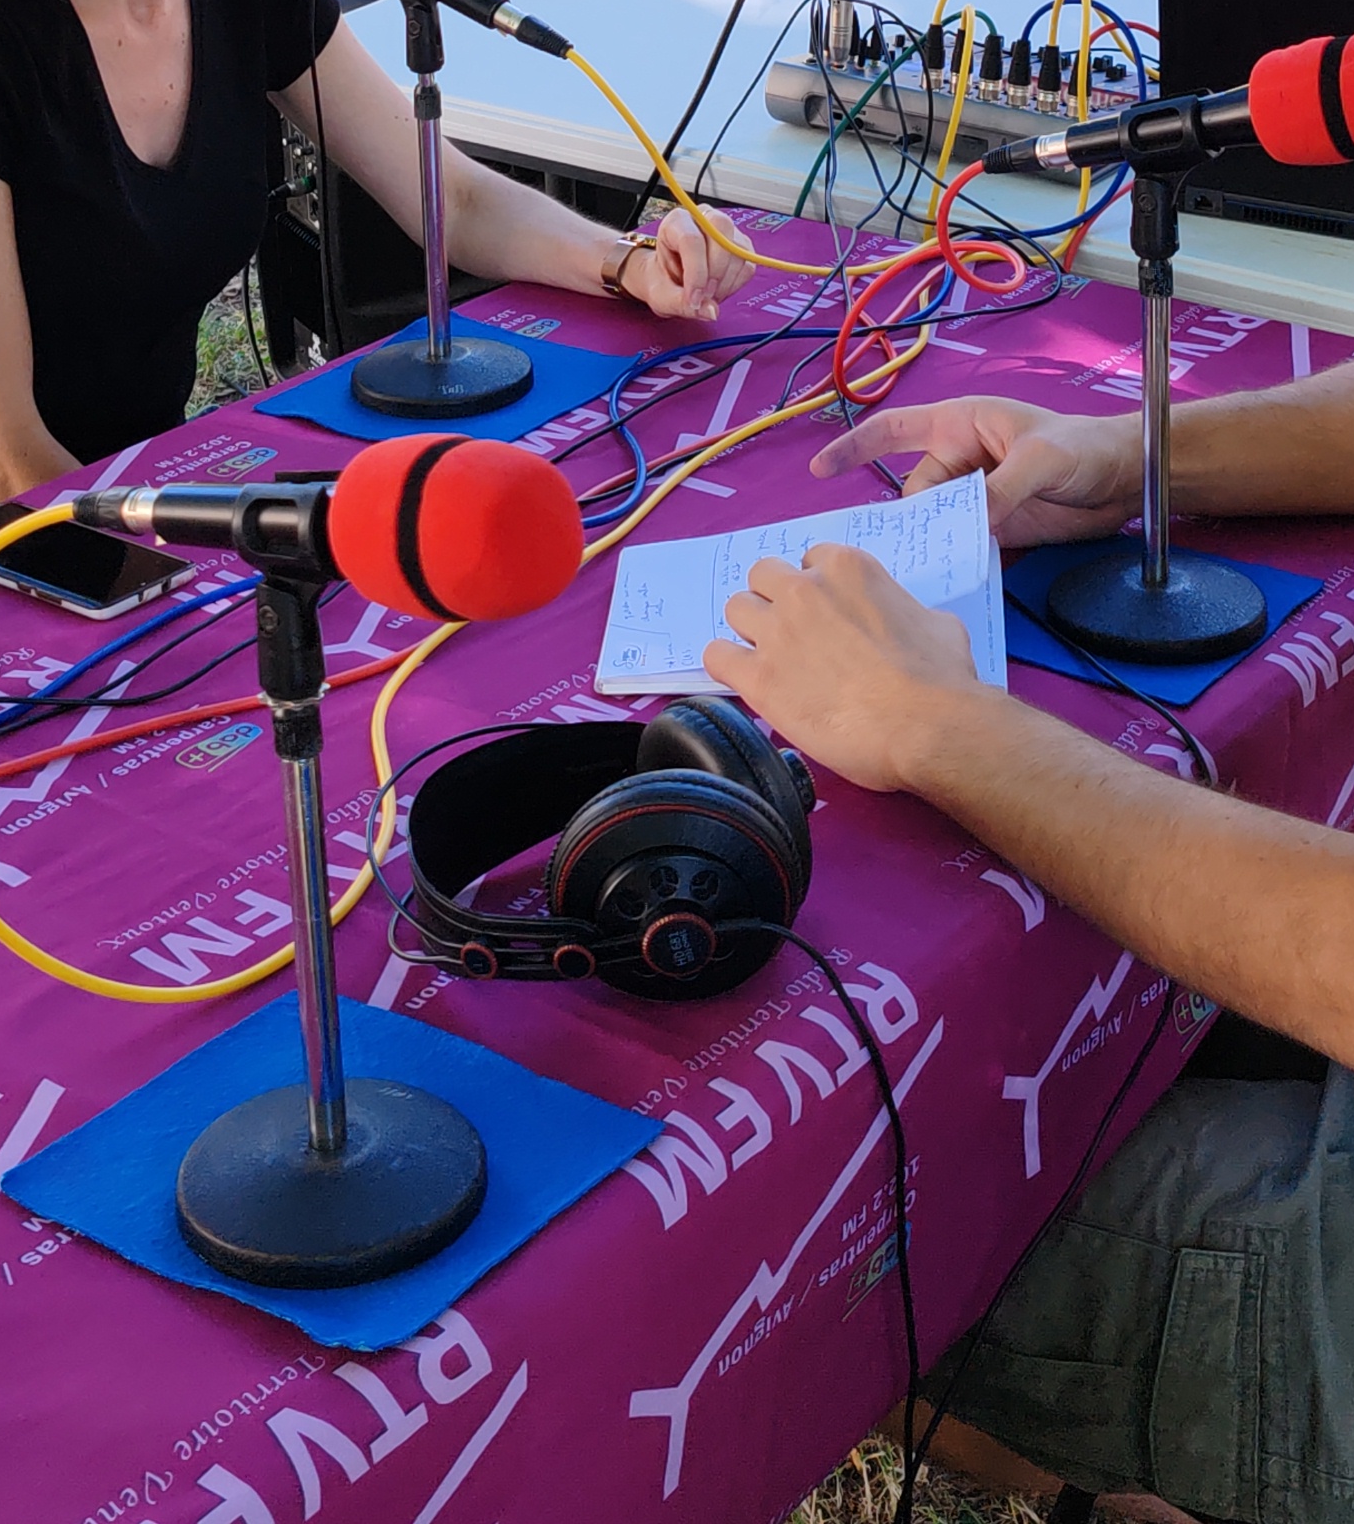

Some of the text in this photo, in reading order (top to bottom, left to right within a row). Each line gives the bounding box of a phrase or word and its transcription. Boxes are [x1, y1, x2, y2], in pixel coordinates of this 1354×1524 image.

[154, 433, 233, 470] 102.2 FM
[155, 440, 252, 485] Carpentras
[496, 672, 590, 721] Ventoux
[1112, 716, 1160, 752] Radi
[0, 783, 93, 836] Avignon
[96, 891, 217, 951] Ventoux
[129, 888, 293, 986] FM
[681, 945, 853, 1075] Rdio Territoire
[1061, 1011, 1123, 1072] Avignon
[619, 961, 919, 1231] RTV FM
[841, 1154, 920, 1241] 12.2 FM
[717, 1294, 795, 1376] Avignon
[173, 1352, 325, 1465] Territoire
[264, 1308, 493, 1521] RTV
